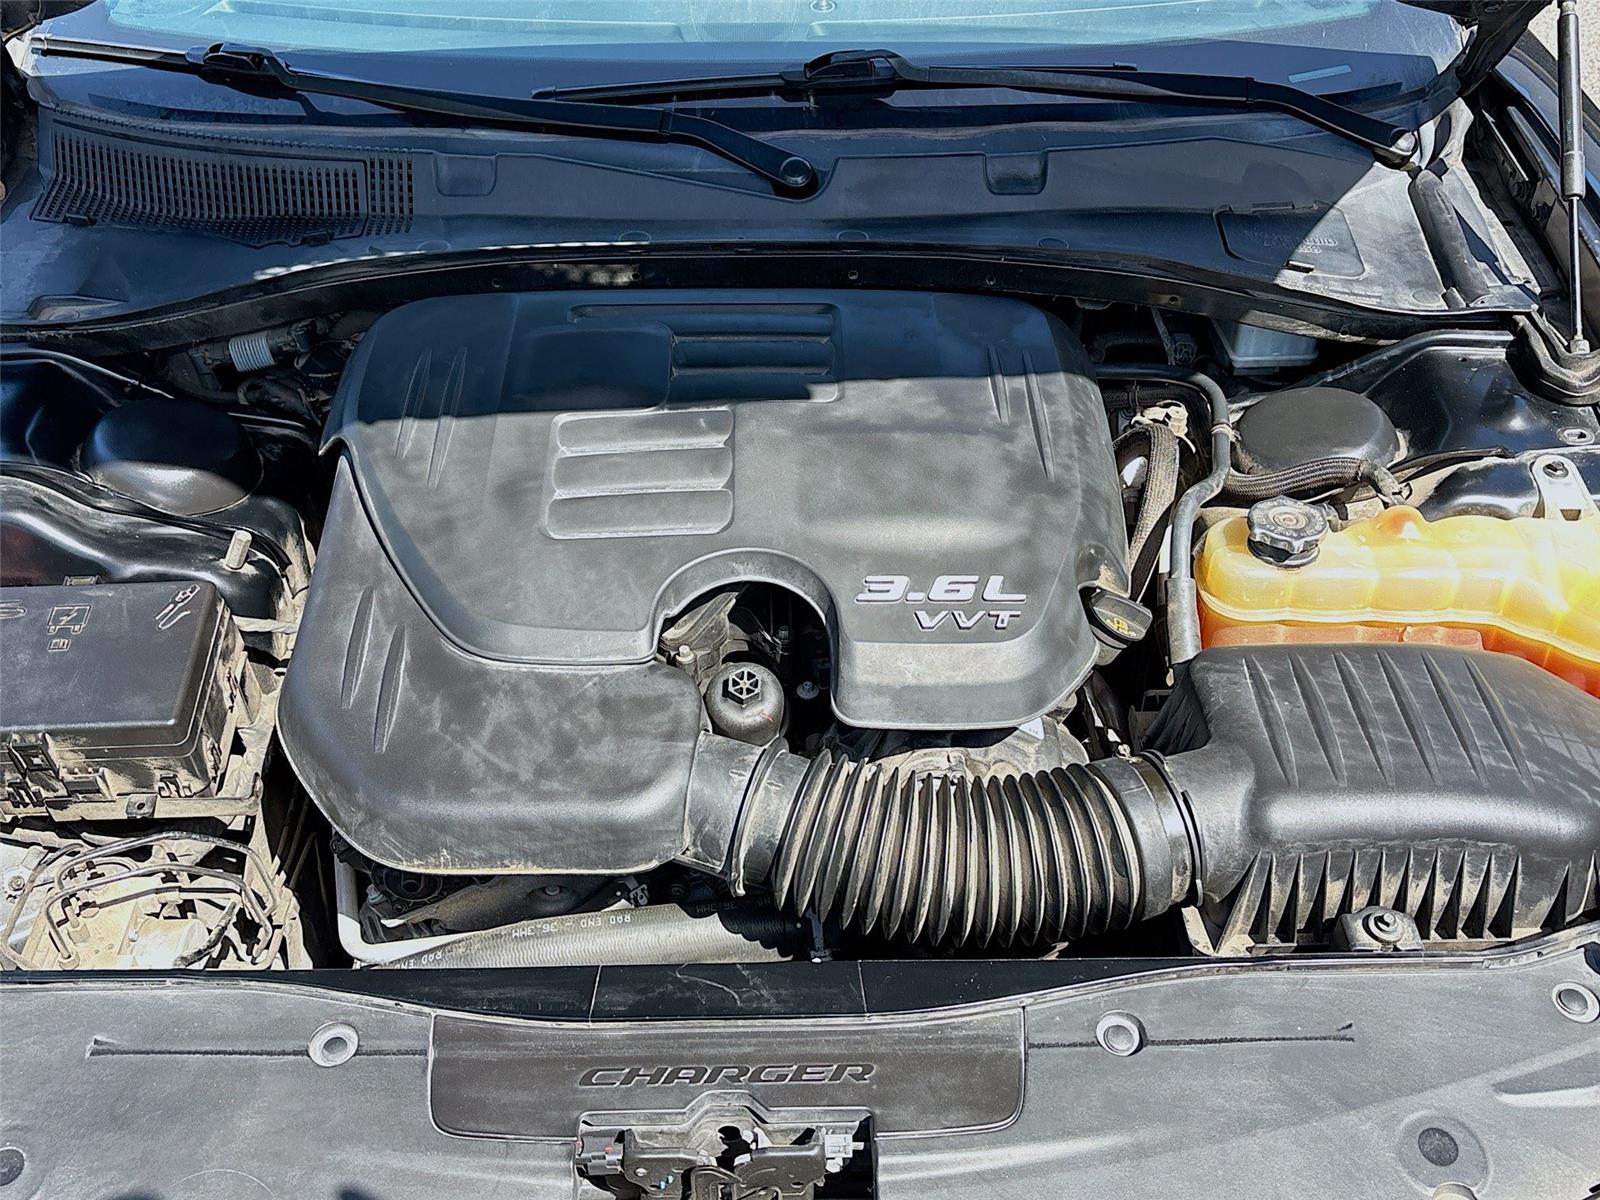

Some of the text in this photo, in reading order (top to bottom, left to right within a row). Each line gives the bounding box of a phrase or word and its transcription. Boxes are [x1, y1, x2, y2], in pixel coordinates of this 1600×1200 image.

[855, 574, 1027, 604] 3.6L
[913, 610, 1022, 632] VVT
[580, 917, 602, 928] END
[609, 914, 631, 925] RAD
[421, 950, 443, 964] RAD
[578, 1063, 877, 1088] CHARGER
